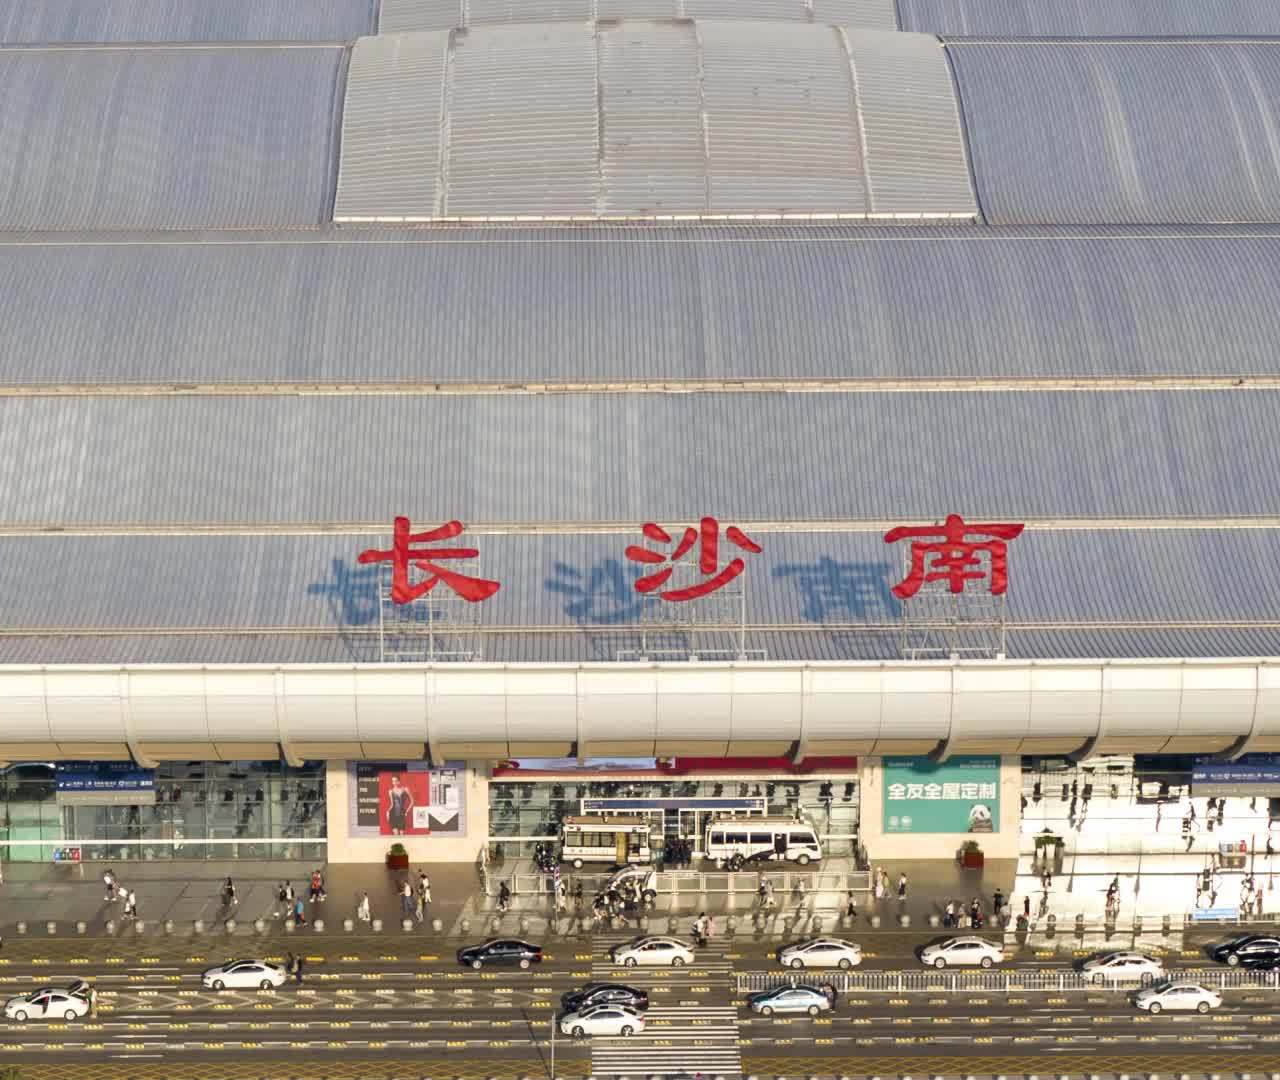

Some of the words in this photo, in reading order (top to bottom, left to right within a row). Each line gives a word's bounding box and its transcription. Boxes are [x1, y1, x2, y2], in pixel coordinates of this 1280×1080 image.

[358, 514, 1025, 604] 长沙南
[887, 783, 997, 800] 全友全屋定制
